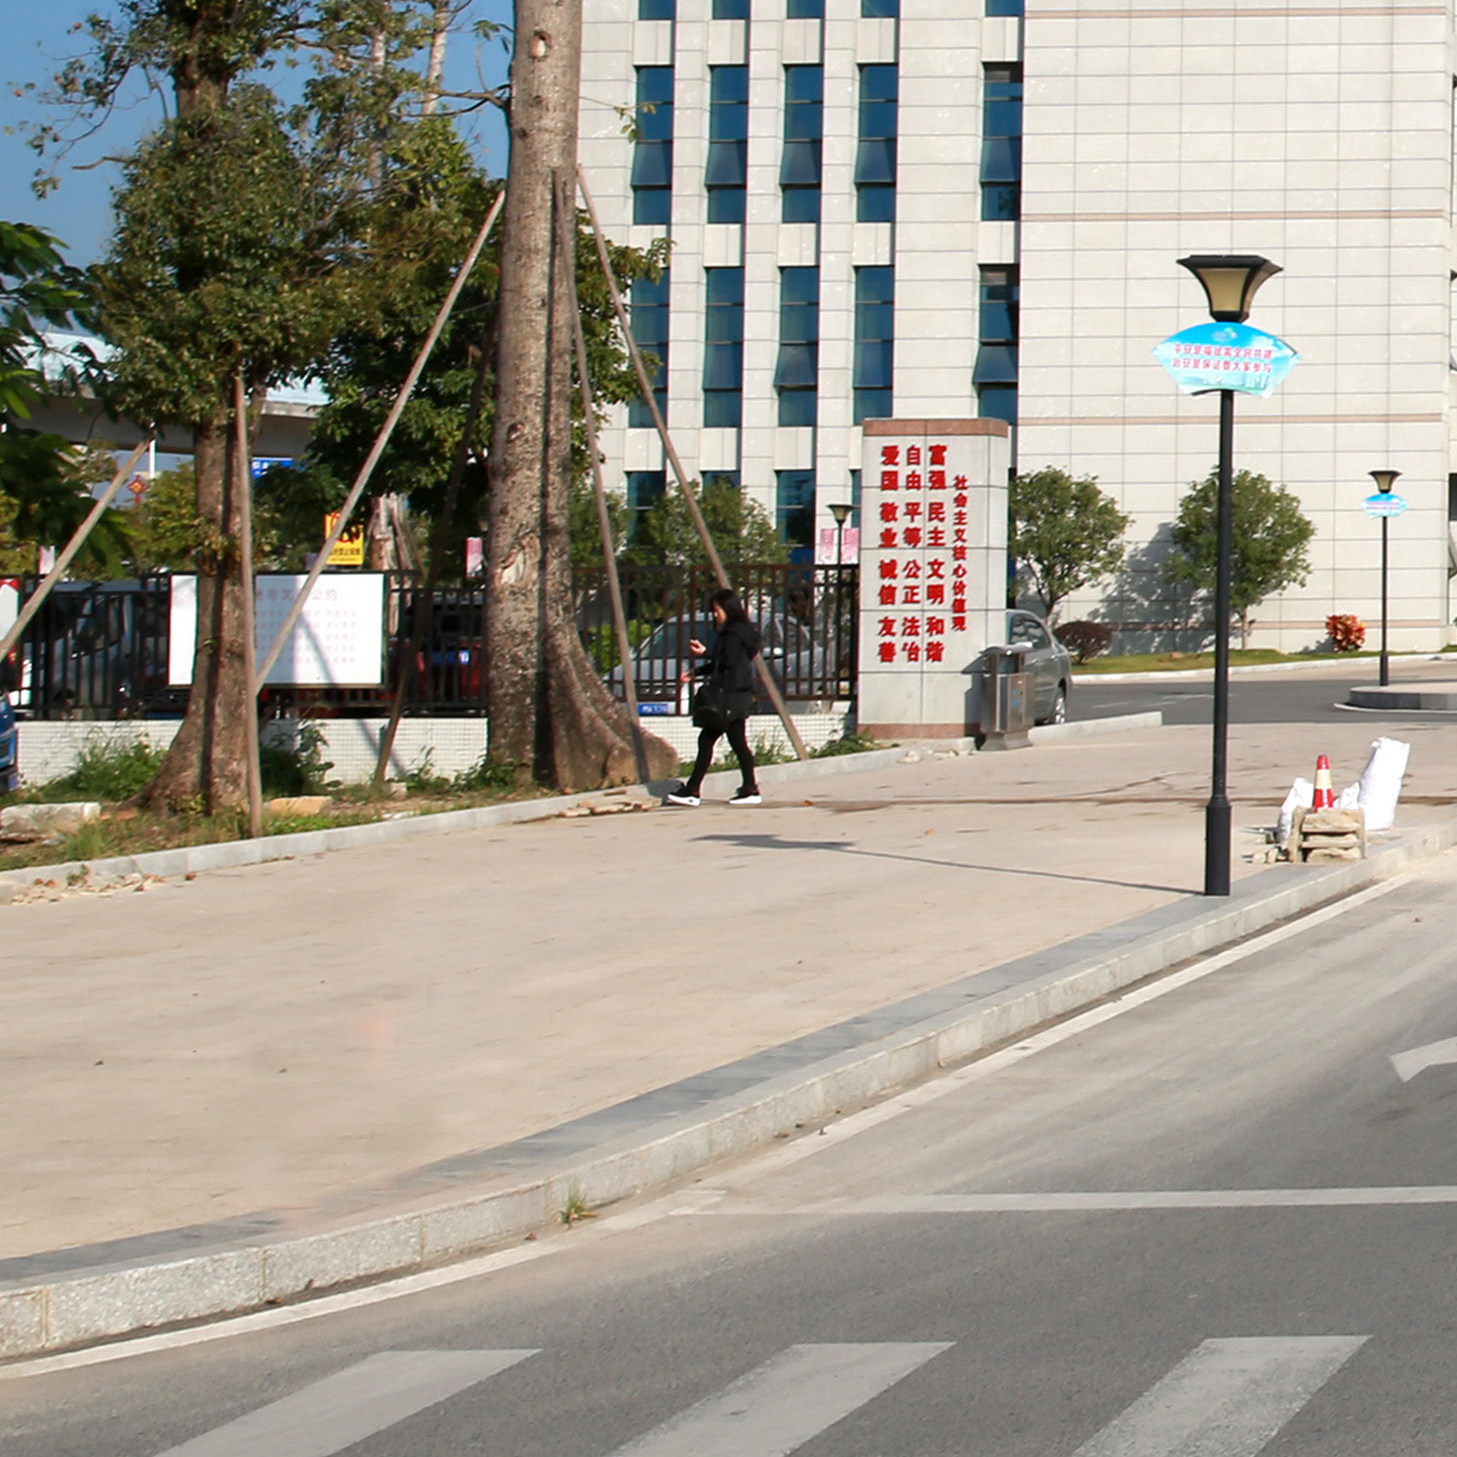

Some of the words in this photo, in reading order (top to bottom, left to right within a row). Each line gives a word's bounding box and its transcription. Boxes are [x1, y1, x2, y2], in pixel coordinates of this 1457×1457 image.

[881, 445, 900, 491] 爱国
[906, 445, 922, 491] 自由
[928, 444, 947, 490] 富强
[879, 502, 899, 548] 敬业
[903, 502, 922, 548] 平等
[928, 501, 946, 547] 民主
[952, 475, 969, 631] 社会主义核心价值观
[878, 559, 898, 605] 诚信
[903, 559, 922, 604] 公正
[927, 559, 945, 604] 文明
[878, 616, 897, 662] 友善
[902, 616, 921, 662] 法治
[926, 616, 945, 662] 和谐
